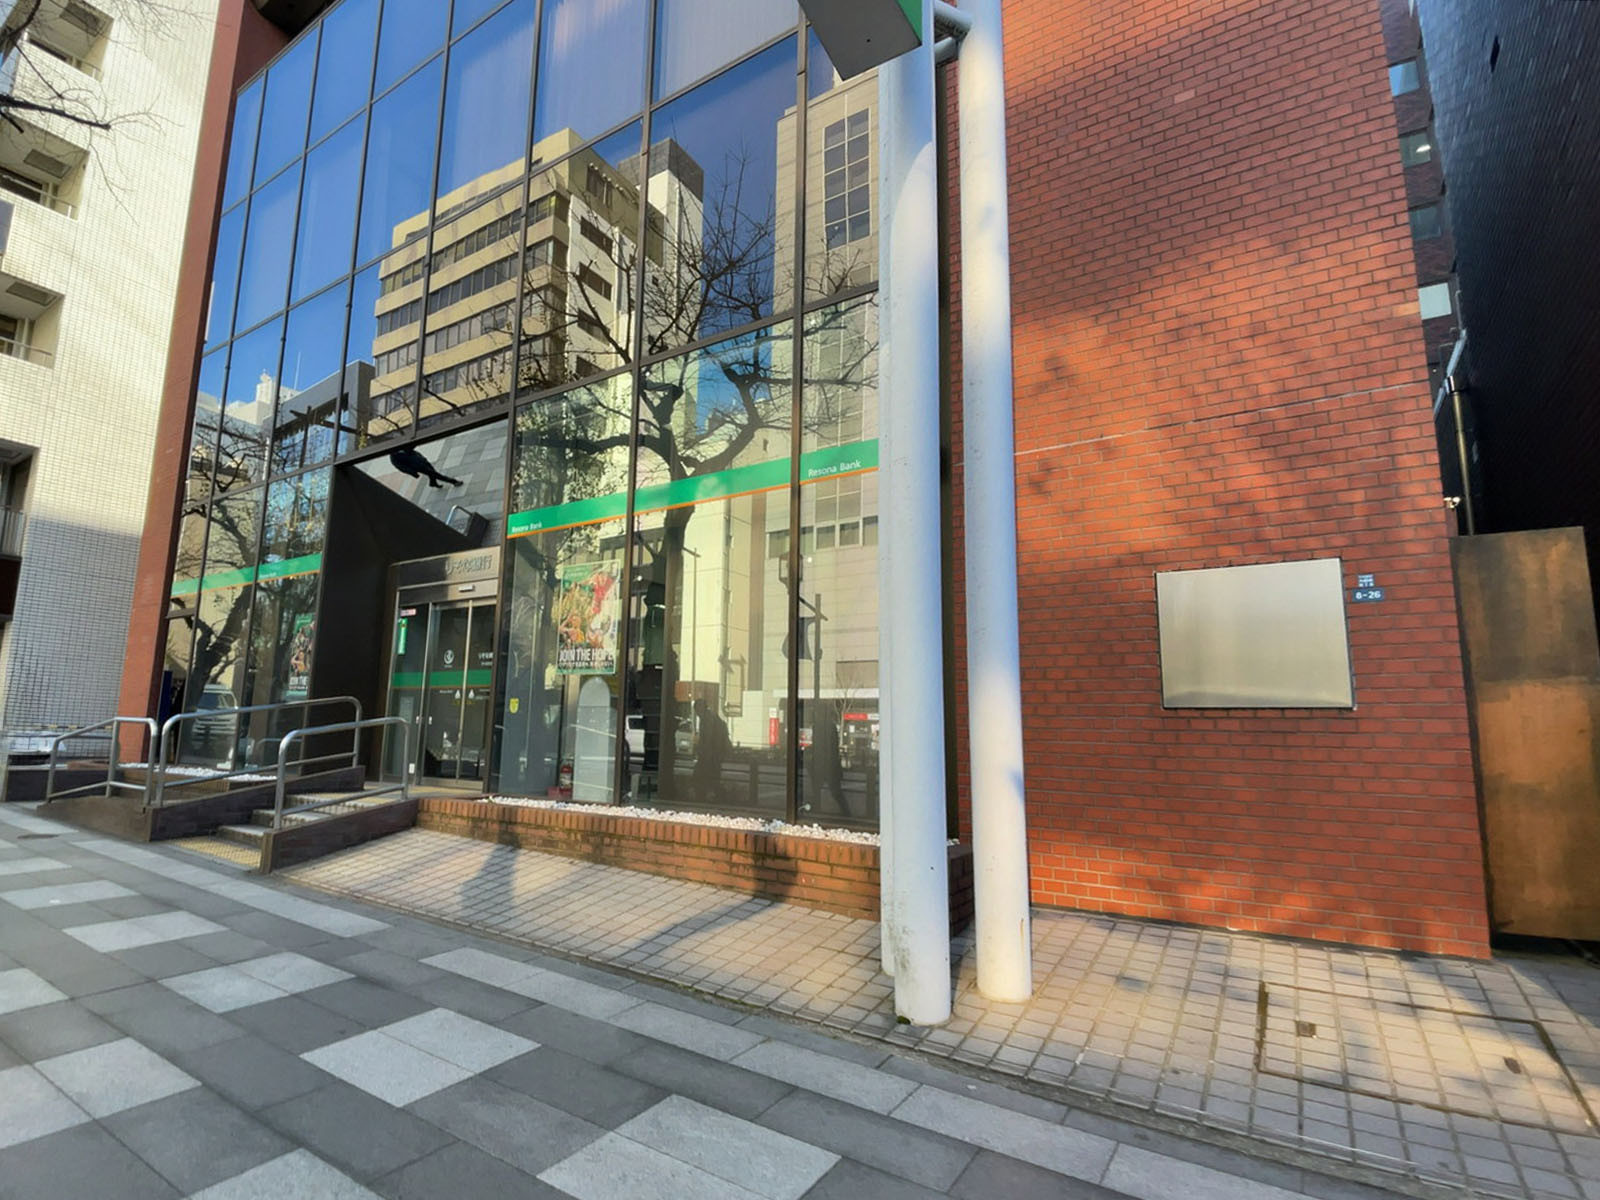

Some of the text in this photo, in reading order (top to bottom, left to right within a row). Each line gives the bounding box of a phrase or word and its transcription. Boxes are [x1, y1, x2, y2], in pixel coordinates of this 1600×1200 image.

[808, 460, 861, 477] Resona Bank
[1355, 590, 1381, 600] 8-26
[576, 647, 591, 661] THE
